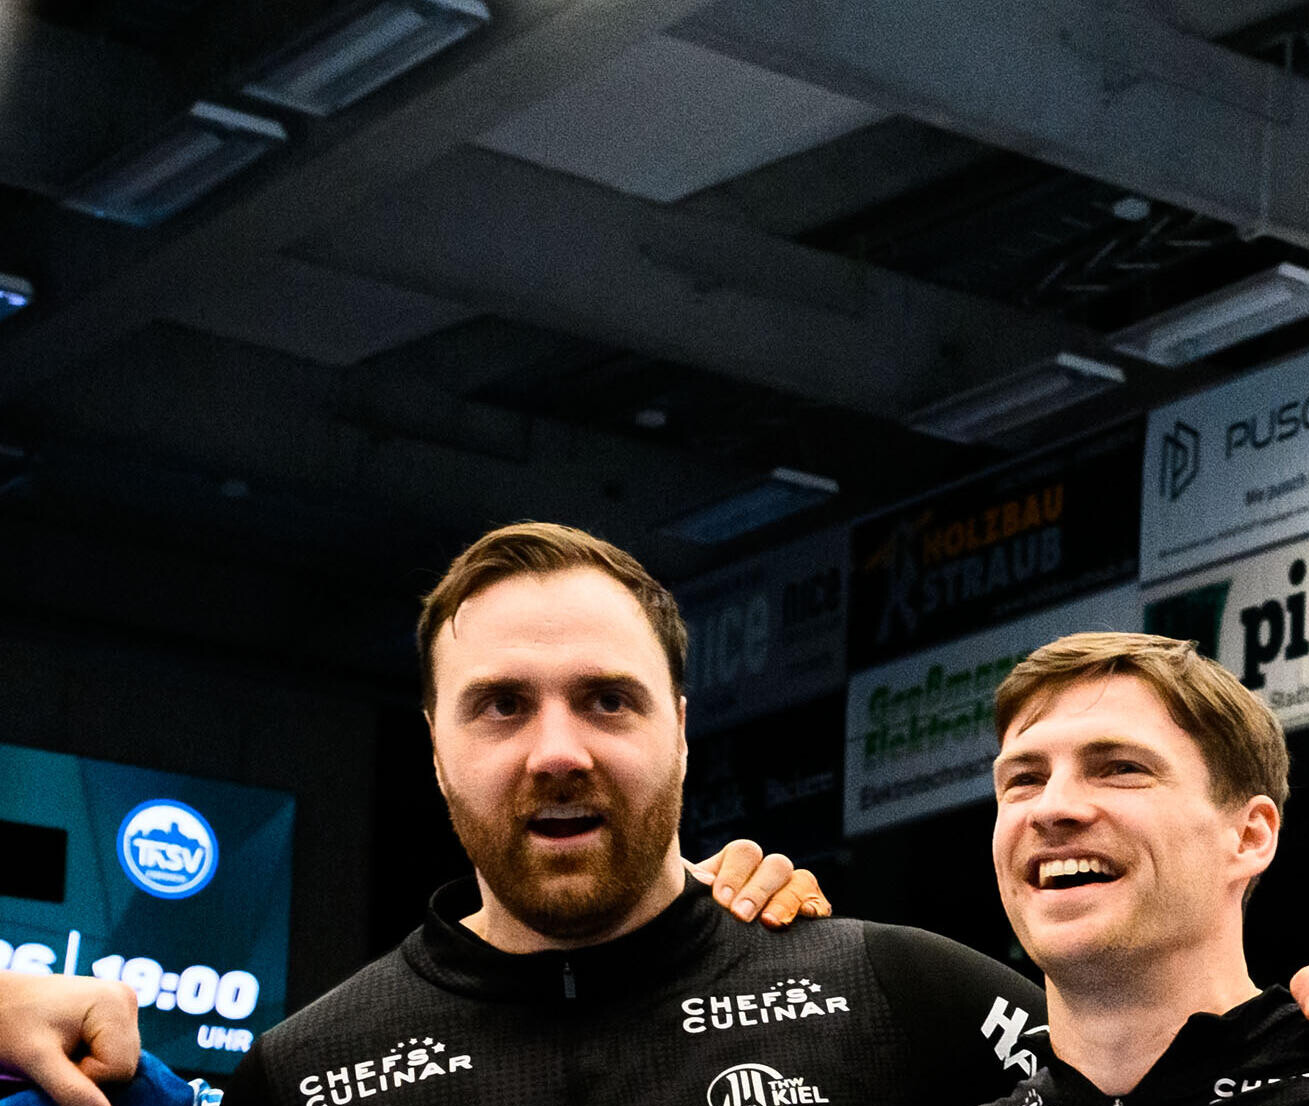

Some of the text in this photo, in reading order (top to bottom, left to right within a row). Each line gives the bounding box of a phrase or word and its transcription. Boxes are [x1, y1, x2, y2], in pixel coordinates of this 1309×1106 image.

[922, 482, 1065, 565] HOLZBAU
[922, 525, 1063, 614] STRAUB
[681, 988, 808, 1016] CHEFS
[683, 997, 850, 1034] CULINAR
[198, 1025, 254, 1053] UHR
[300, 1049, 429, 1096] CHEFS
[768, 1077, 804, 1091] THW
[772, 1086, 830, 1106] KIEL
